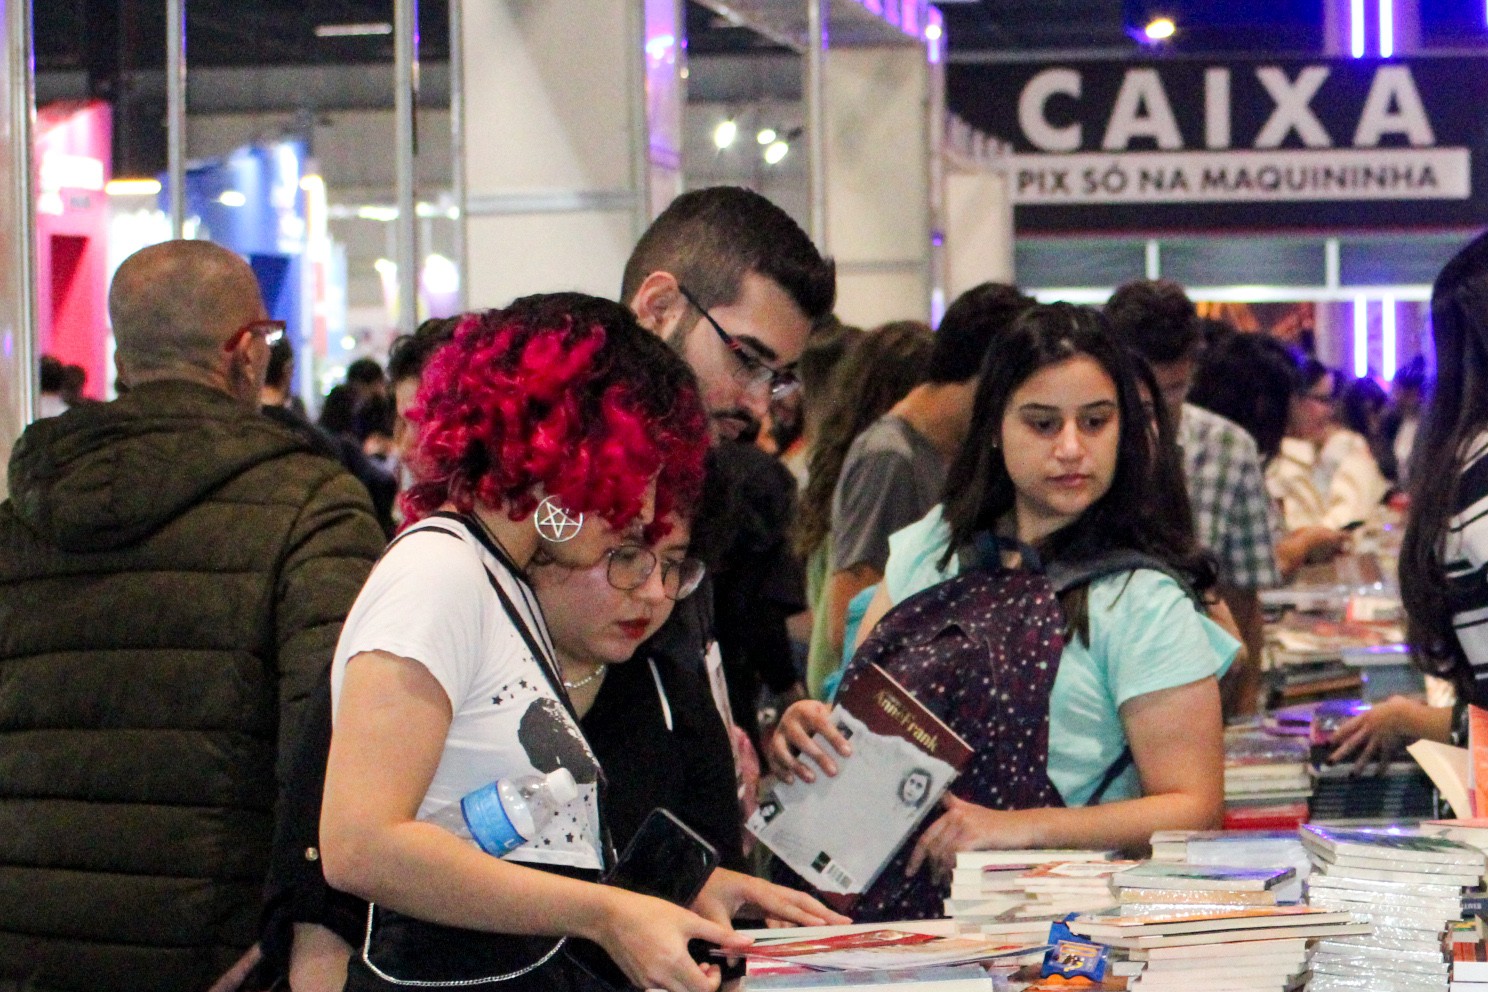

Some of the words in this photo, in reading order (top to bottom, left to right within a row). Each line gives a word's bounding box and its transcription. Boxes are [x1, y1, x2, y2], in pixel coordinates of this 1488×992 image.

[1017, 65, 1436, 152] CAIXA
[1018, 168, 1071, 197] PIX
[1083, 162, 1128, 196] SÓ
[1140, 167, 1194, 194] NA
[1201, 164, 1439, 194] MAQUININHA
